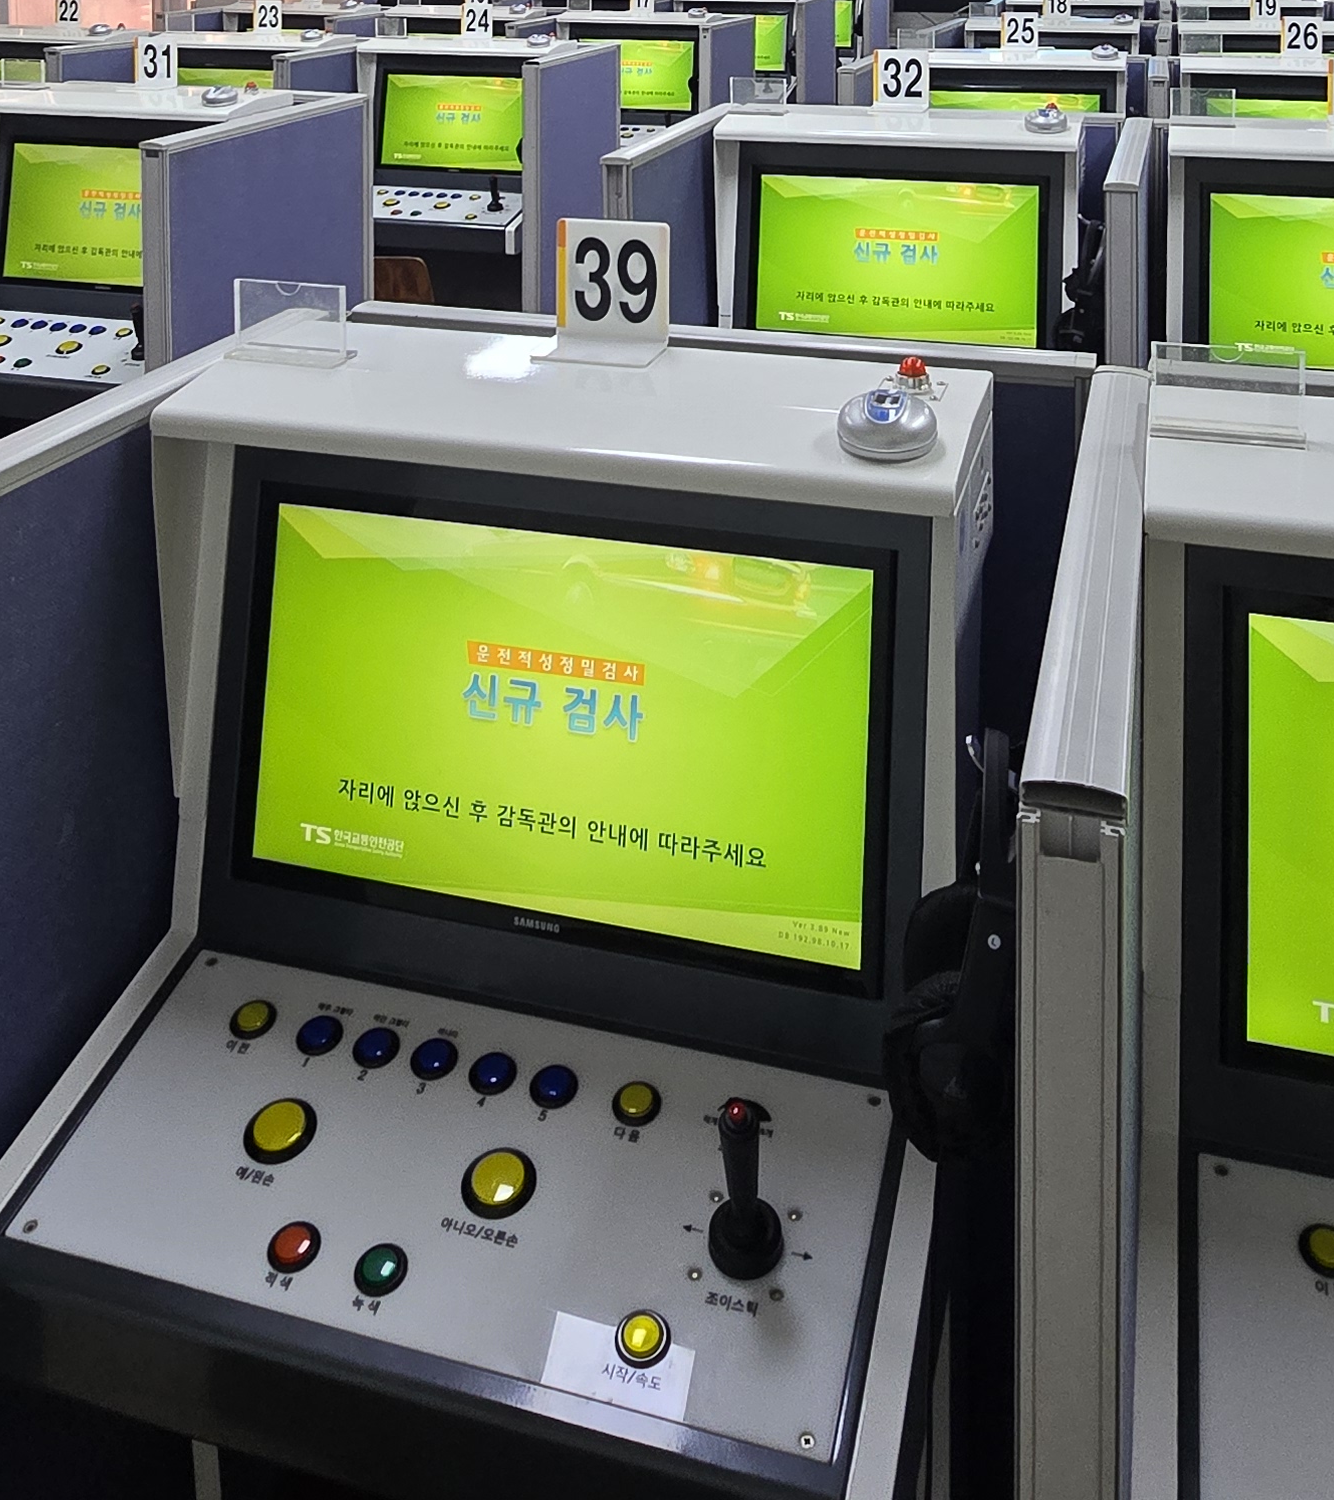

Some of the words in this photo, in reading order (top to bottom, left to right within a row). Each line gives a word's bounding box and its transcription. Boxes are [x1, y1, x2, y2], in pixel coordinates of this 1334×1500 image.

[59, 0, 78, 21] 22
[259, 5, 278, 27] 23
[466, 9, 489, 32] 24
[1007, 18, 1034, 43] 25
[1287, 23, 1317, 49] 26
[143, 43, 173, 79] 31
[883, 58, 922, 97] 32
[79, 201, 107, 218] 신규
[854, 242, 891, 263] 신규
[900, 244, 939, 266] 검사
[20, 261, 33, 270] TS
[575, 237, 657, 323] 39
[796, 291, 824, 302] 자리에
[827, 292, 855, 305] 앉으신
[859, 294, 869, 305] 후
[872, 296, 910, 308] 감독관의
[913, 298, 942, 311] 안내에
[946, 300, 995, 313] 따라주세요
[779, 311, 795, 321] TS
[1254, 320, 1287, 332] 자리에
[1291, 322, 1324, 335] 앉으신
[1234, 342, 1253, 352] TS
[476, 644, 639, 682] 운전적성정밀검사
[462, 673, 543, 726] 신규
[563, 686, 644, 742] 검사
[300, 822, 332, 845] TS
[338, 778, 395, 808] 자리에
[403, 788, 461, 819] 앉으신
[468, 800, 488, 822] 후
[496, 804, 577, 840] 감독관의
[587, 820, 649, 851] 안내에
[658, 831, 767, 869] 따라주세요
[513, 916, 560, 934] SAMSUNG
[792, 920, 807, 930] Ver
[832, 927, 850, 937] New
[301, 1056, 311, 1068] 1
[356, 1069, 369, 1082] 2
[416, 1082, 427, 1095] 3
[475, 1096, 487, 1108] 4
[536, 1109, 548, 1123] 5
[235, 1165, 275, 1188] 예/왼손
[440, 1216, 519, 1248] 아니오/오른손
[704, 1291, 759, 1318] 조이스틱
[602, 1362, 663, 1392] 시작/속도
